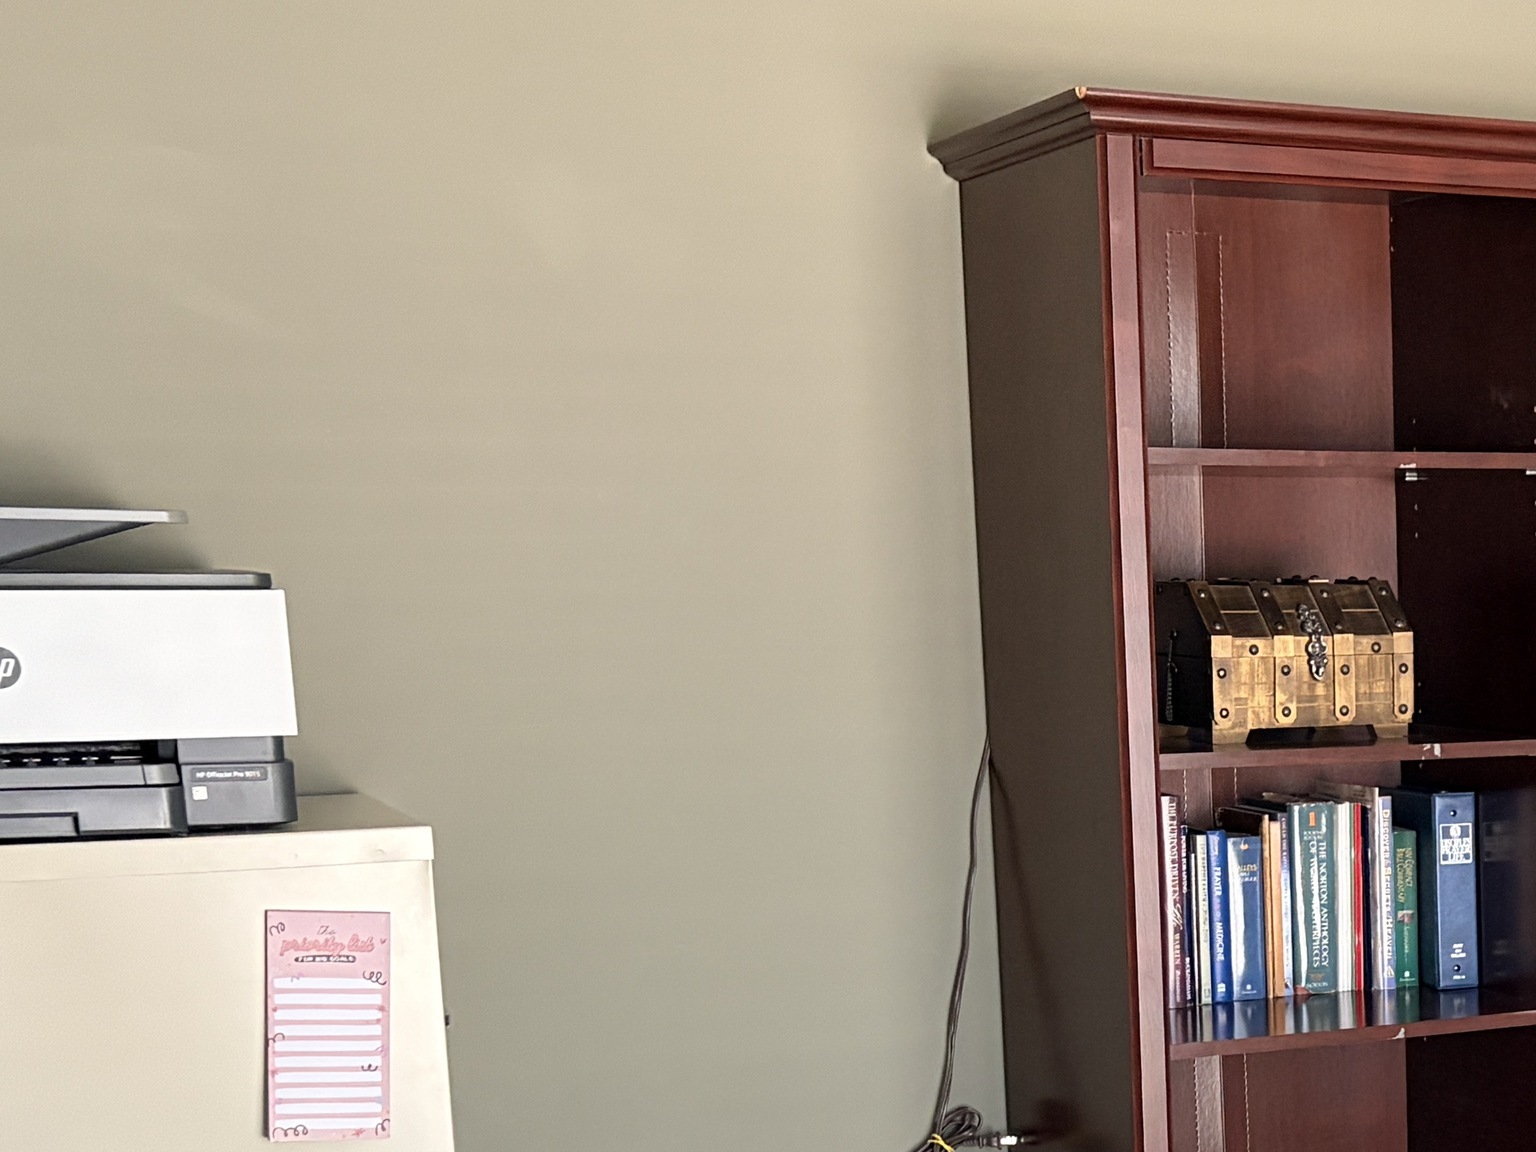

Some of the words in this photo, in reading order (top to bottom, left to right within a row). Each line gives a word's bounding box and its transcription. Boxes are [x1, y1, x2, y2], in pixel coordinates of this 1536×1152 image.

[0, 657, 16, 683] p
[1318, 841, 1326, 859] THE
[1319, 862, 1327, 904] NORTON
[1320, 906, 1329, 966] ANTHOLOGY
